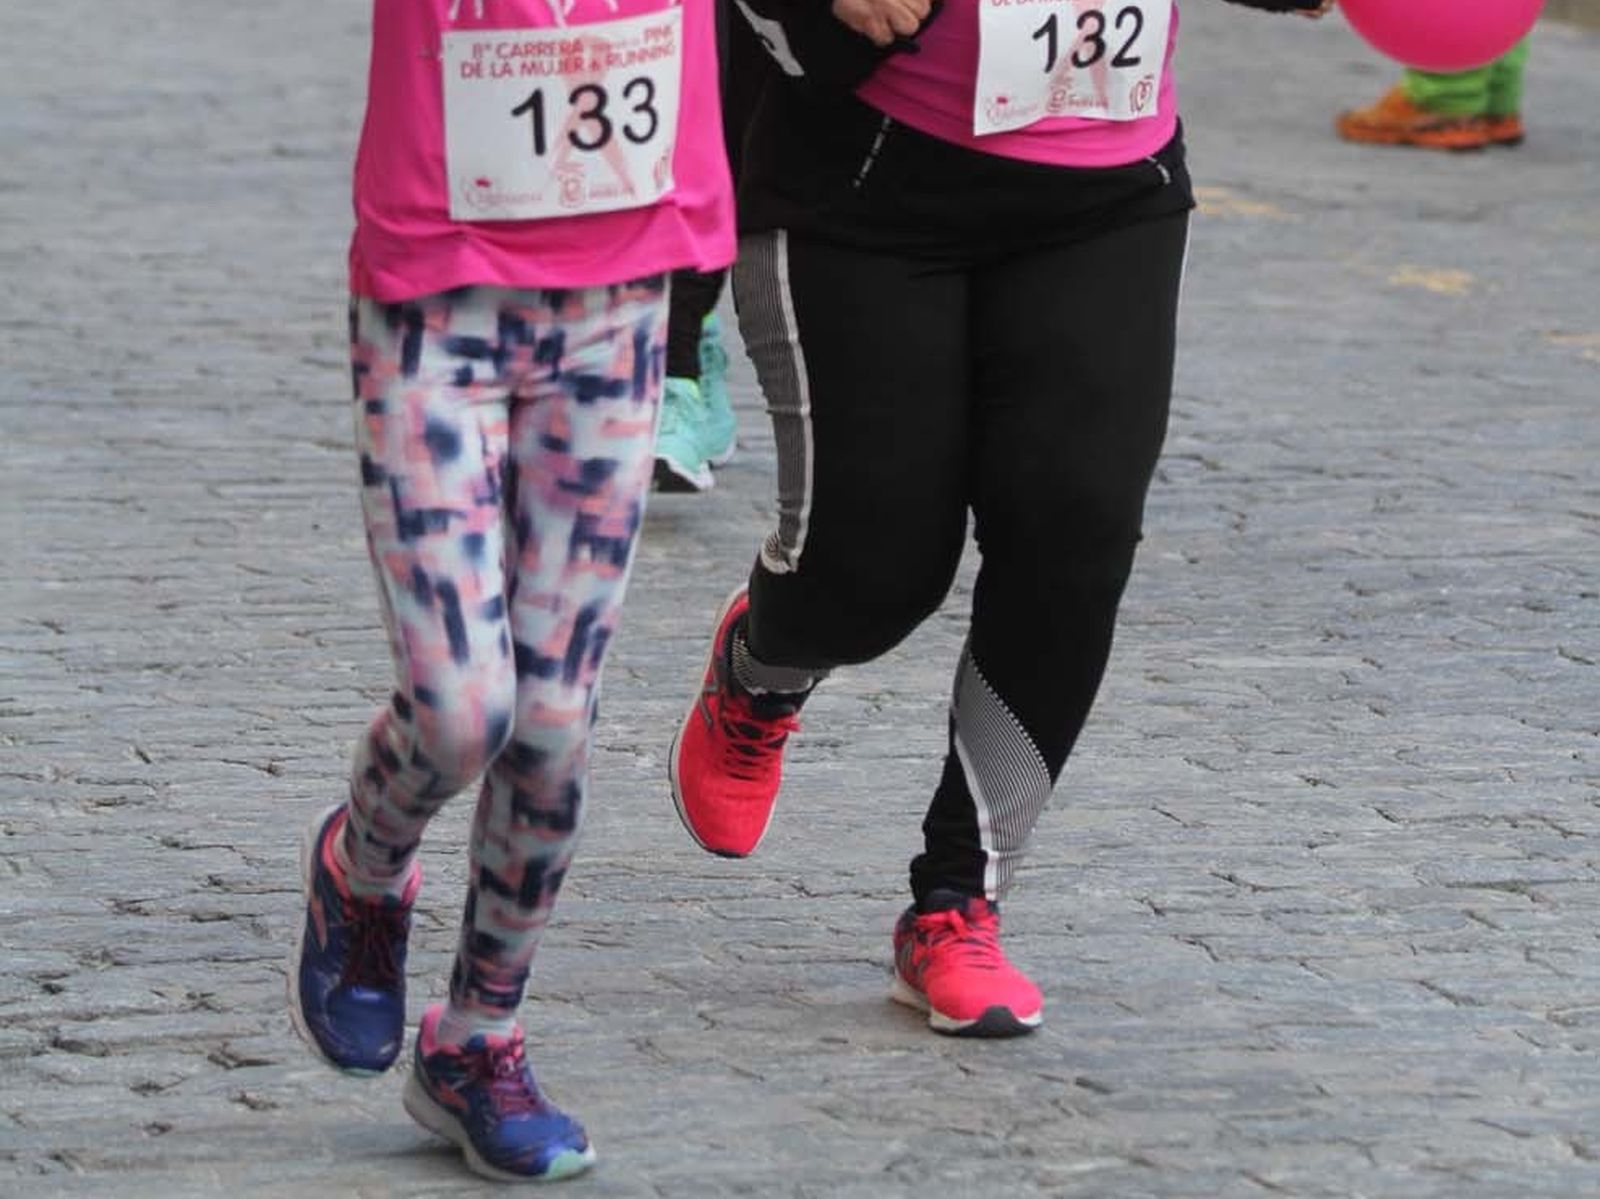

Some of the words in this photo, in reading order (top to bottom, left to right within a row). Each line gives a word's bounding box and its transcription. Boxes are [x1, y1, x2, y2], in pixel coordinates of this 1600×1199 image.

[461, 61, 483, 79] DE
[490, 61, 513, 78] LA
[519, 57, 584, 76] MUJER
[606, 43, 676, 68] RUNNING
[495, 39, 584, 59] CARRERA
[1032, 6, 1143, 73] 132
[511, 76, 658, 156] 133
